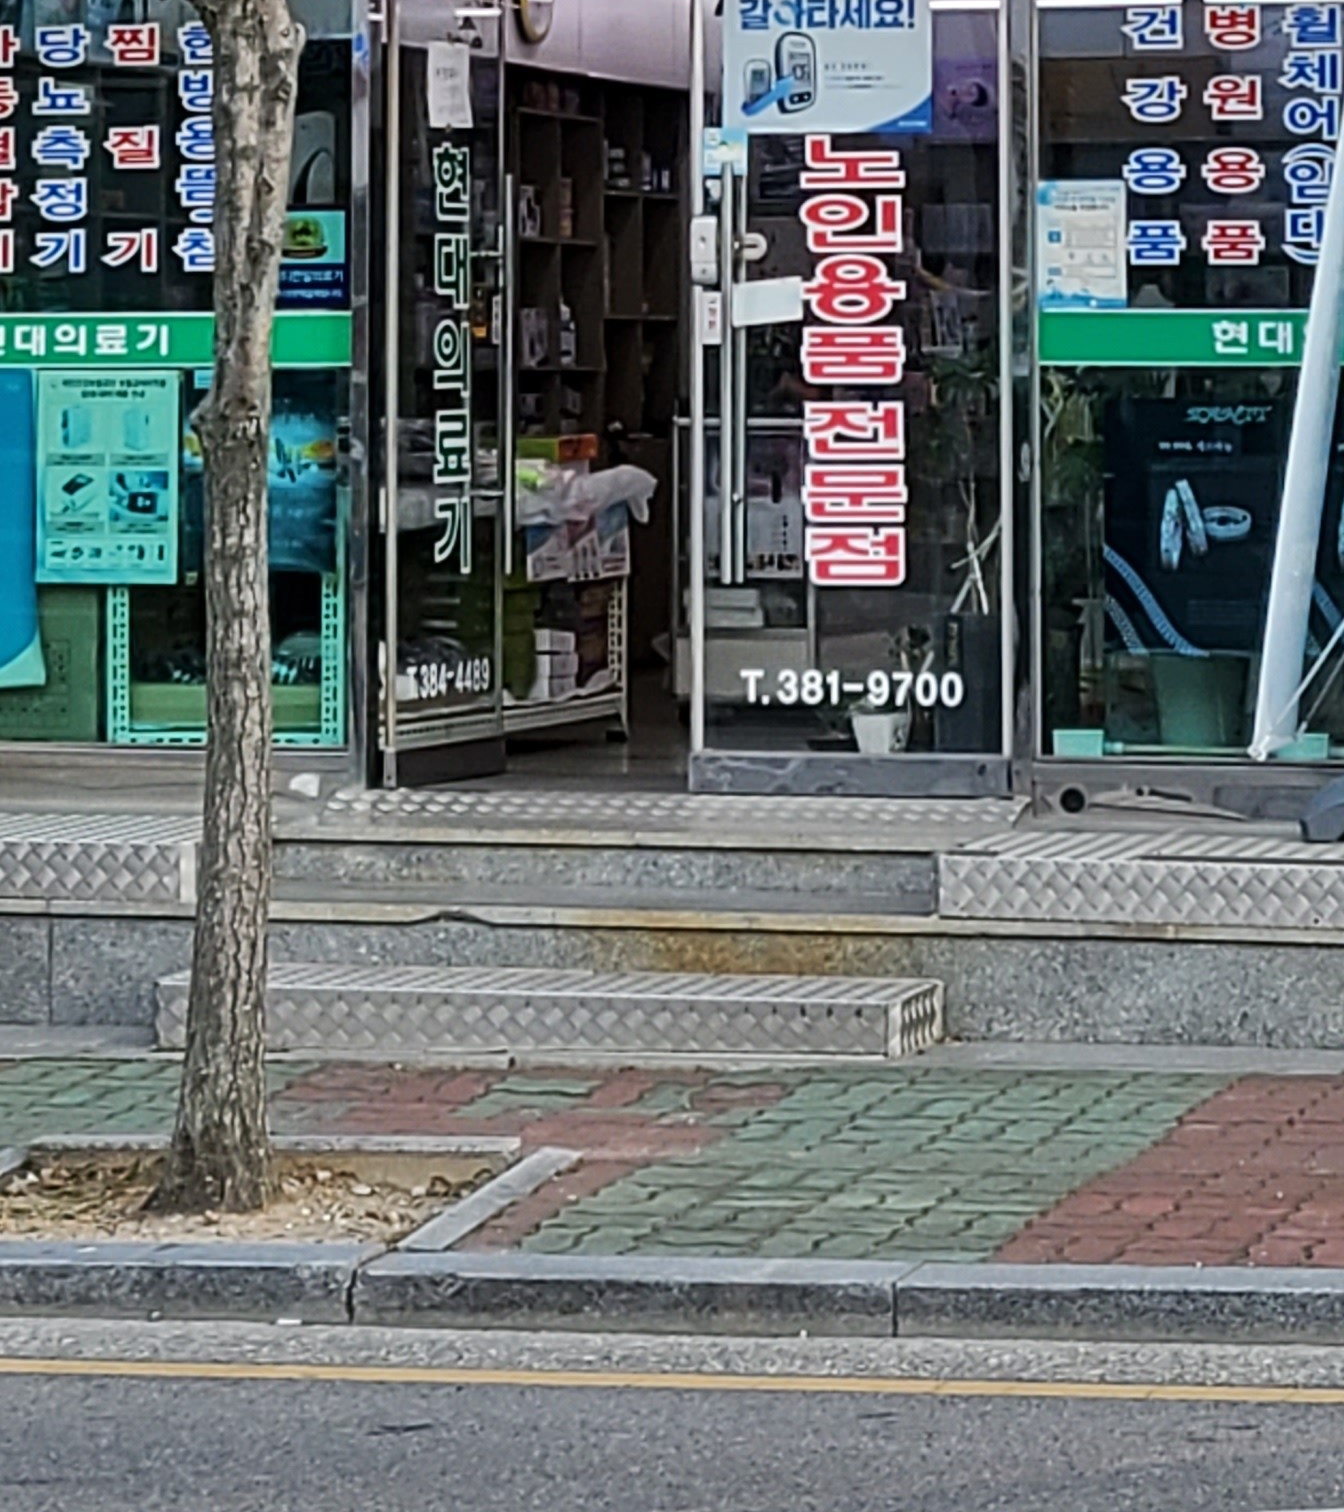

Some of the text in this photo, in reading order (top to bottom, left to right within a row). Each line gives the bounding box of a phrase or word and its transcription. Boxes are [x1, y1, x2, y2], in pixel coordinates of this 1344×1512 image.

[32, 25, 90, 272] 당뇨측정기
[104, 25, 159, 272] 찜질기
[1122, 4, 1187, 265] 건강용품
[1202, 4, 1265, 265] 병원용품
[434, 141, 471, 575] 현대의료기
[800, 133, 907, 586] 노인용품전문점
[738, 668, 964, 708] T.381-9700
